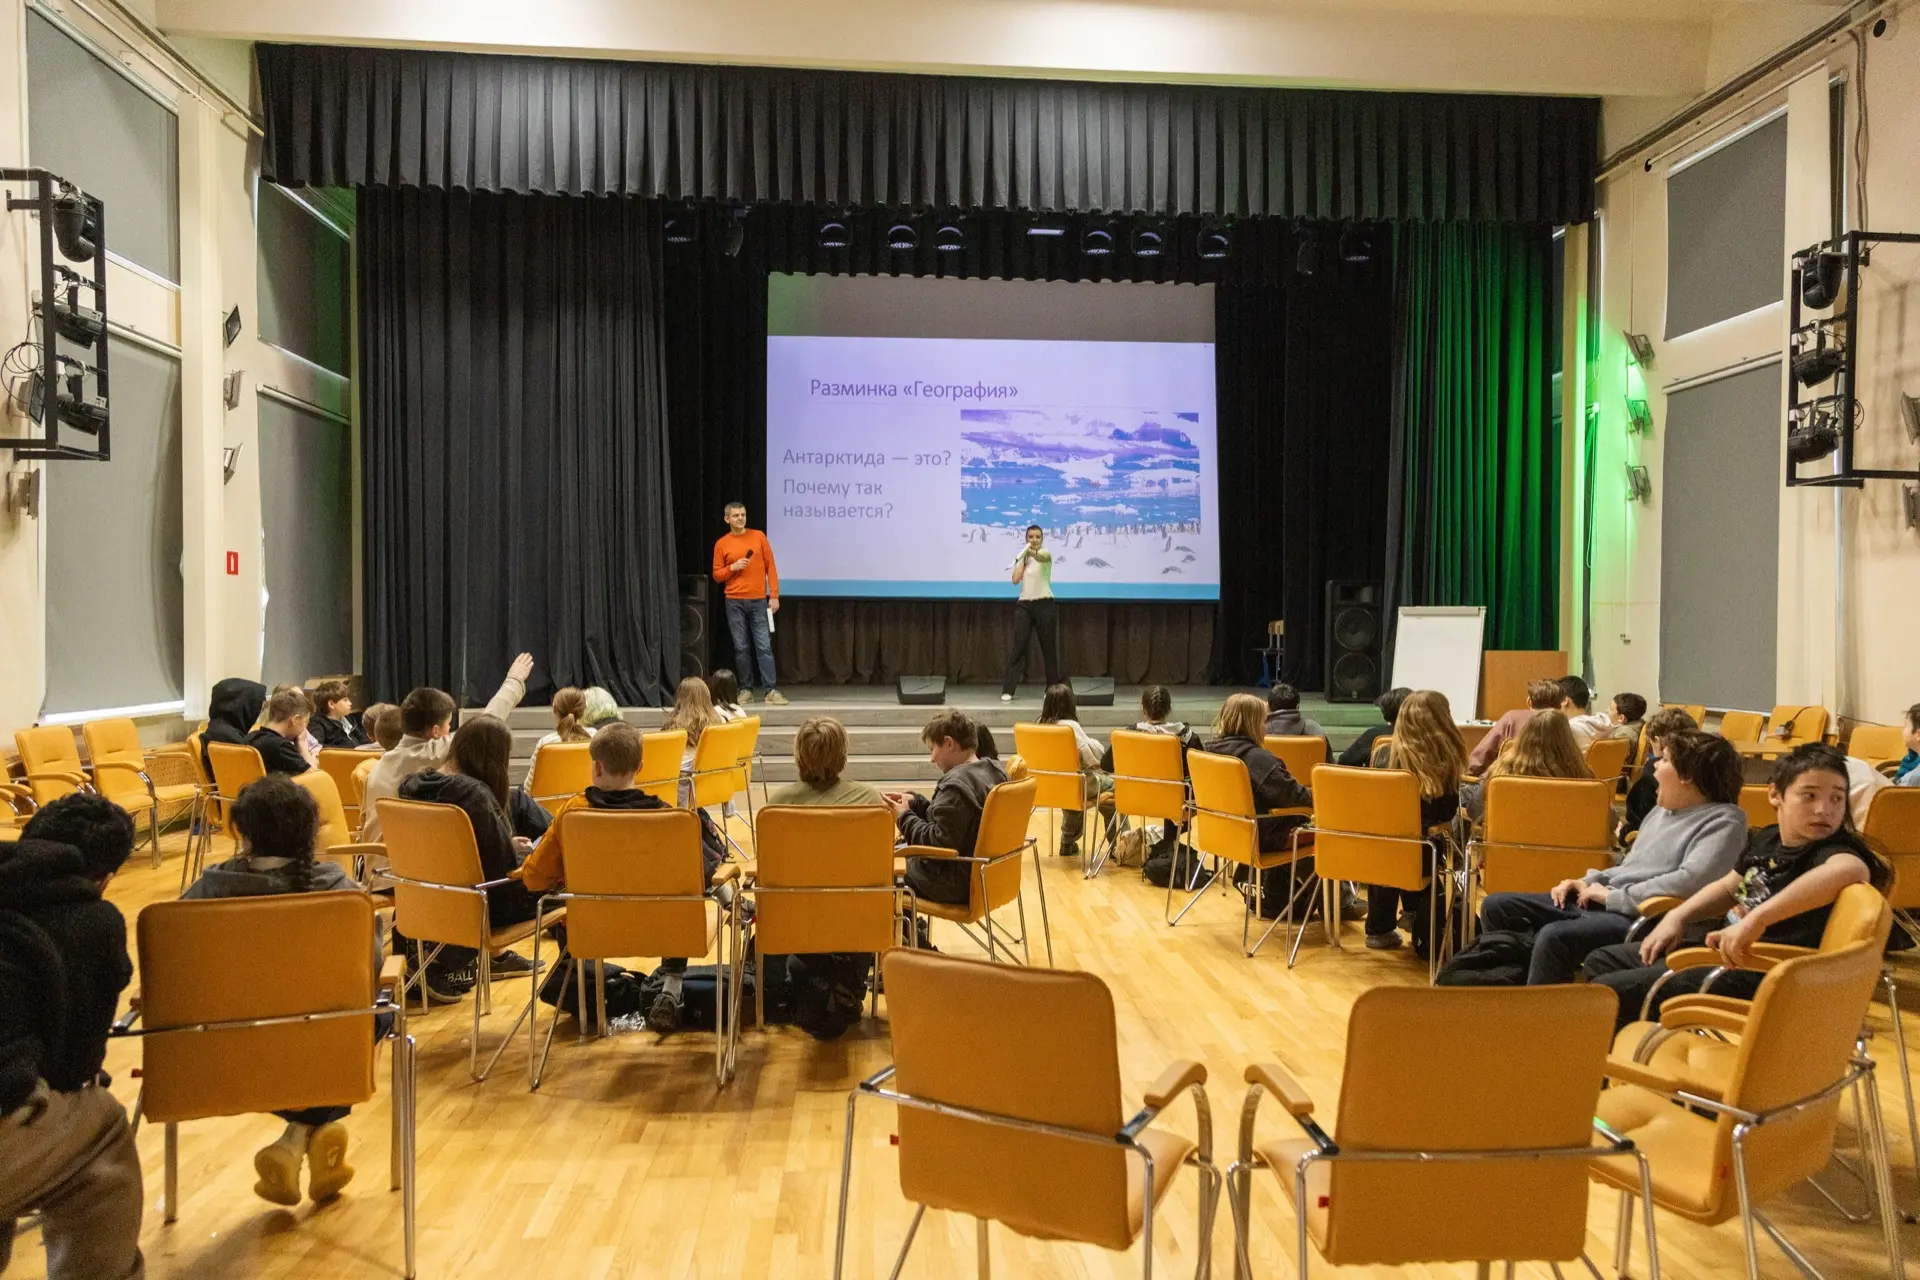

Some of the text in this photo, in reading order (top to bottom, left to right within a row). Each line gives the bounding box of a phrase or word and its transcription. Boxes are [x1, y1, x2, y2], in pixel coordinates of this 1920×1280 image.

[811, 379, 1018, 401] Разминка «География»
[783, 449, 885, 467] Антарктида
[914, 450, 951, 466] это?
[784, 479, 883, 498] Почему так
[783, 502, 893, 518] называется?
